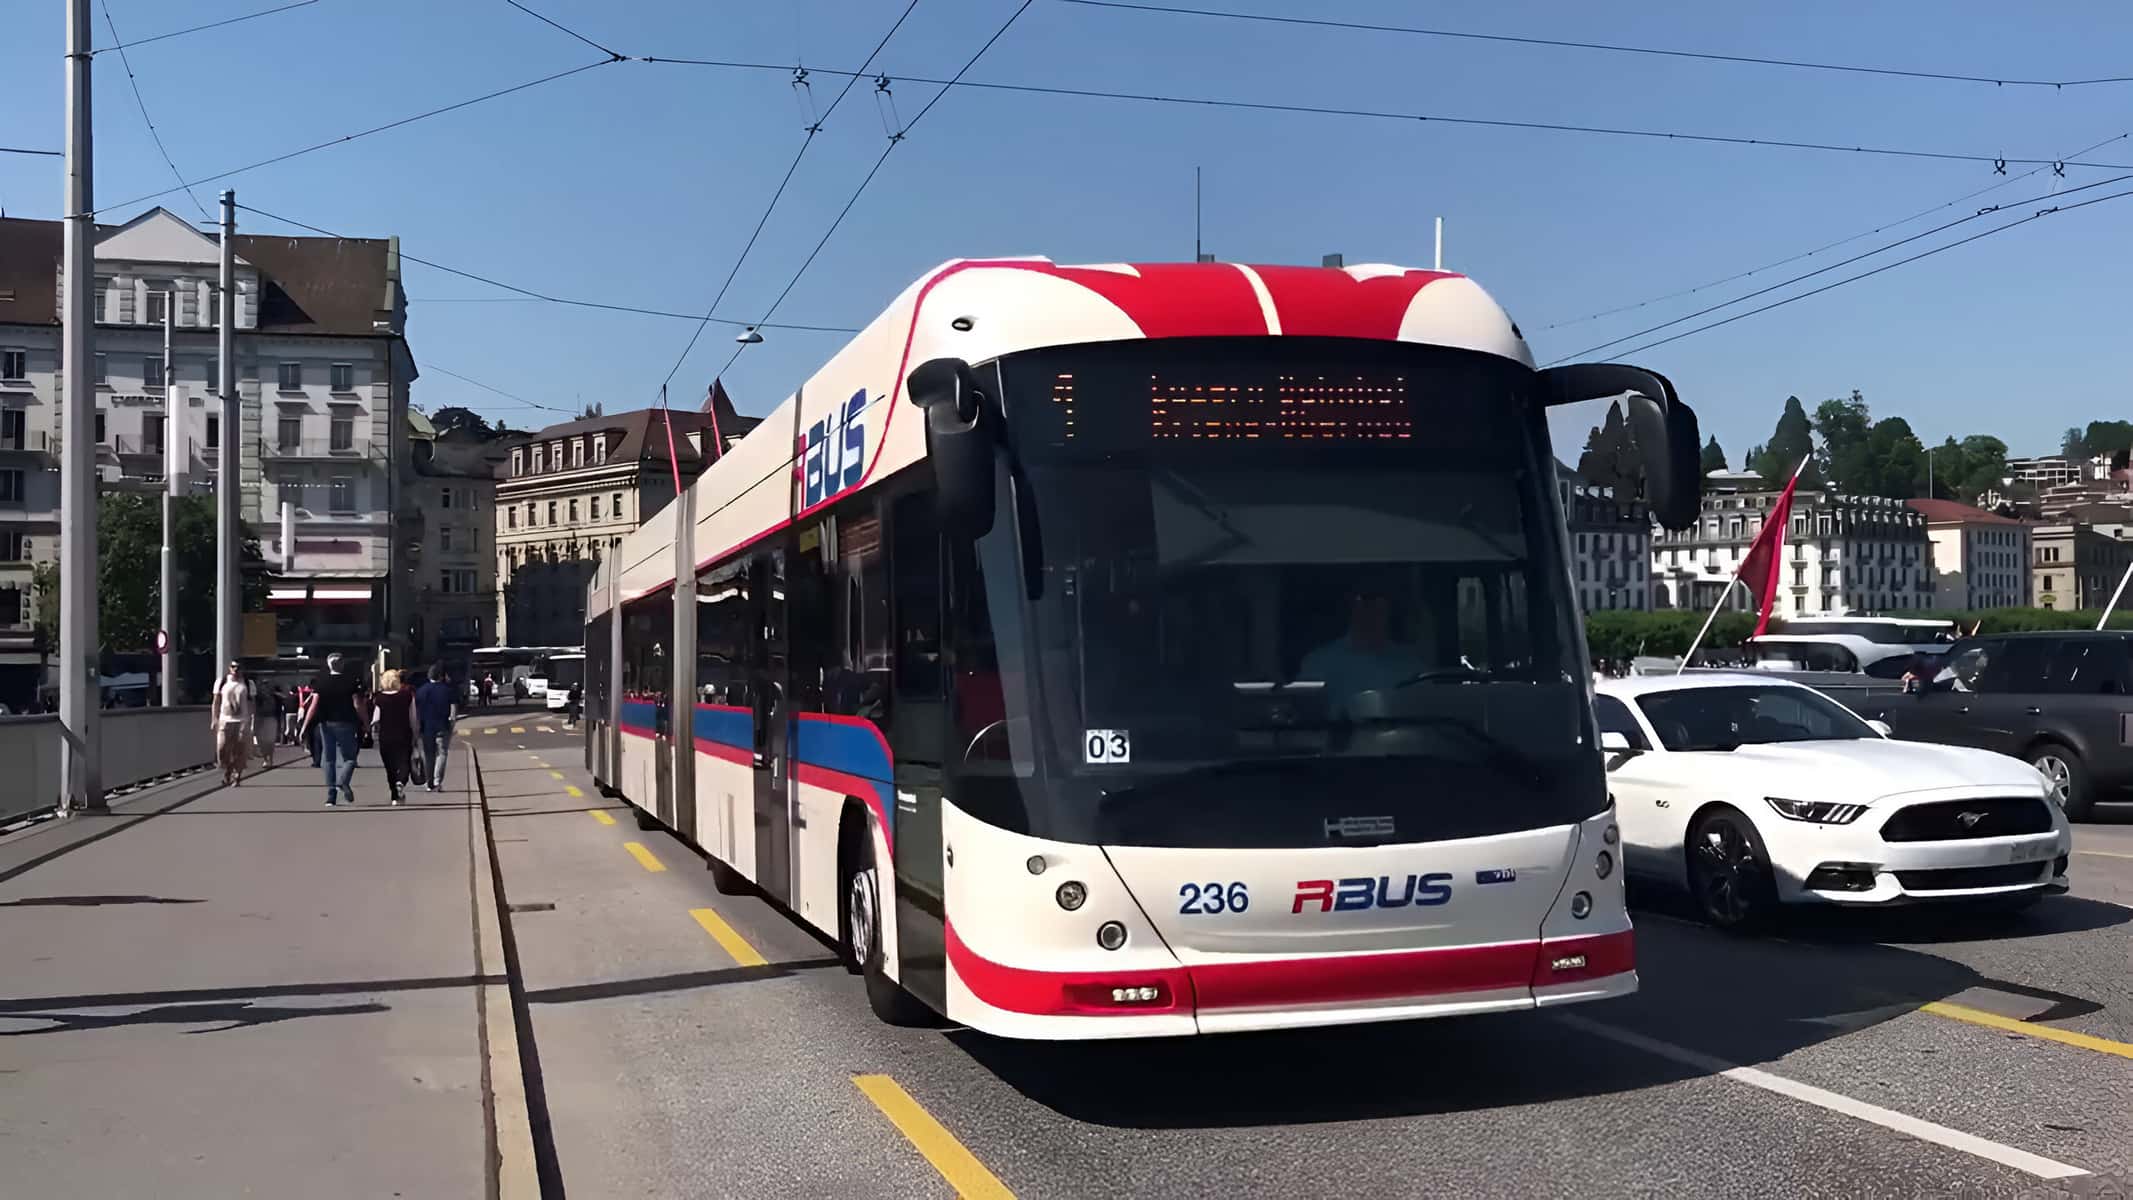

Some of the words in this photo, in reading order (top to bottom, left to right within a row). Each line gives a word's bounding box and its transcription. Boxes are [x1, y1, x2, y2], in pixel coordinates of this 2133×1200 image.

[1088, 734, 1127, 759] 03
[1179, 882, 1249, 915] 236
[1291, 873, 1453, 914] RBUS
